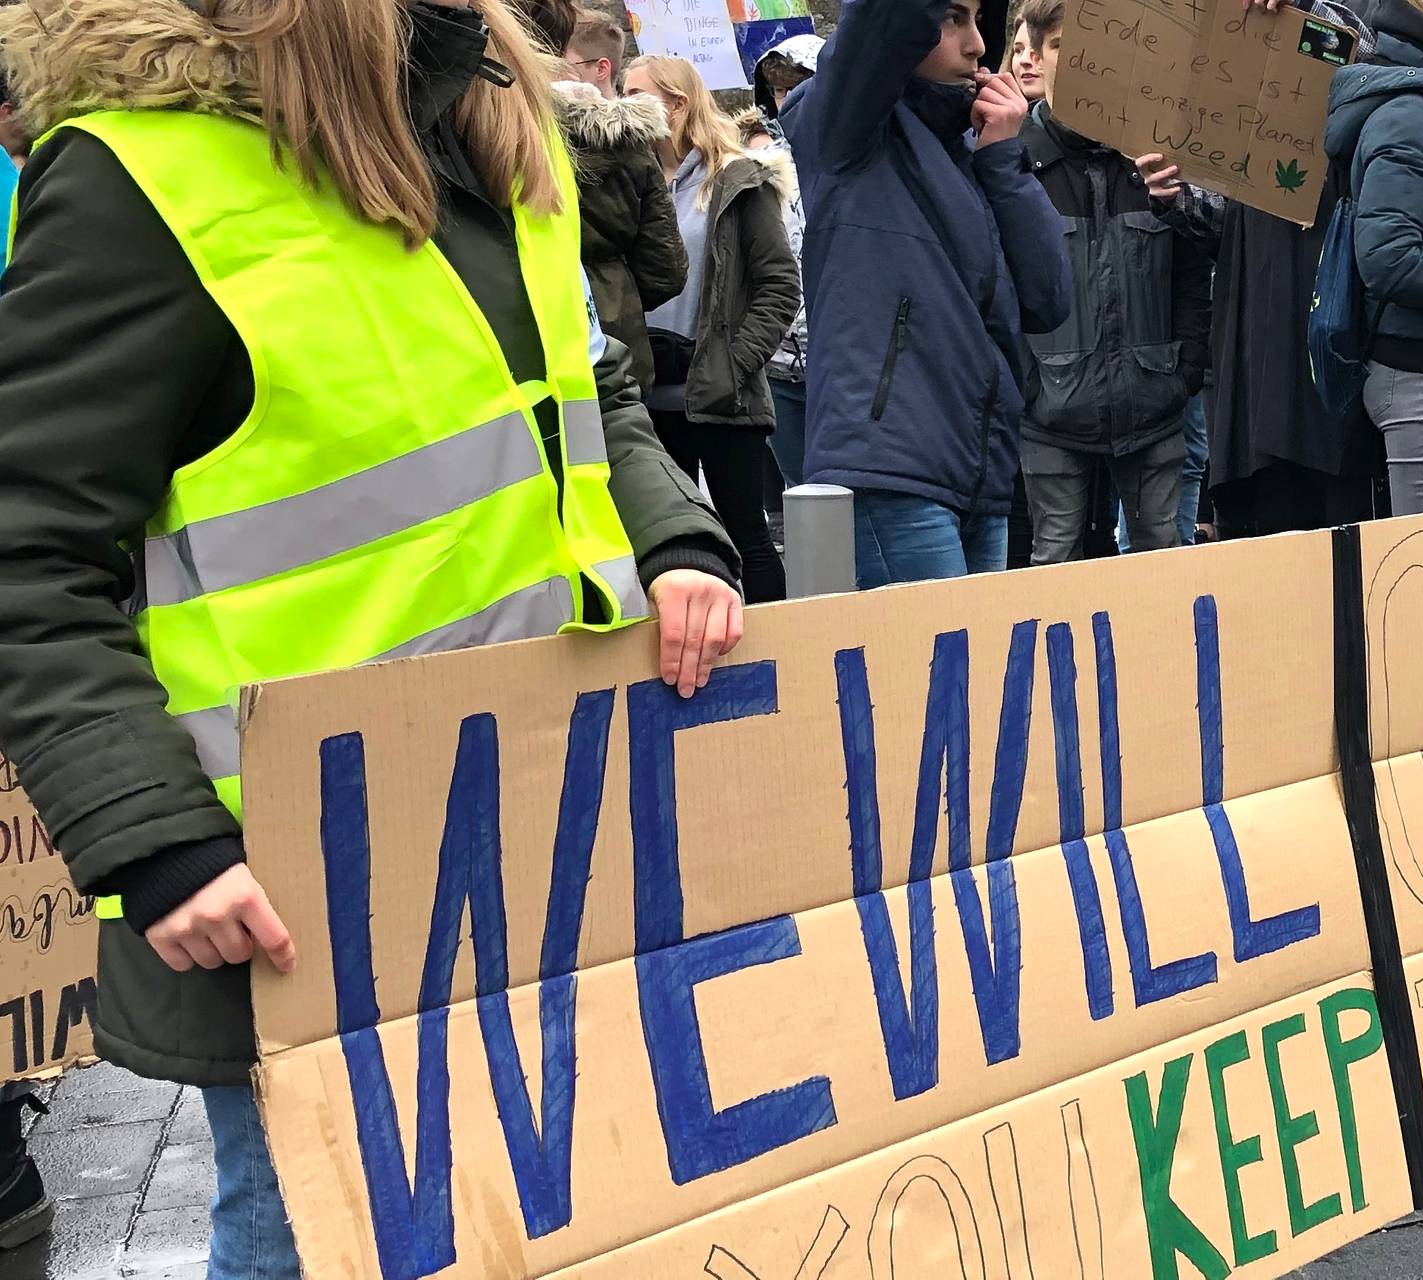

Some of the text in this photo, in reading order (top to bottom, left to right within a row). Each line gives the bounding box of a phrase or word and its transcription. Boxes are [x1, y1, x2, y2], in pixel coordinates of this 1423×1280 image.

[1069, 48, 1116, 78] der
[1238, 104, 1318, 155] Planet
[1075, 96, 1132, 127] mit
[1190, 53, 1233, 84] es
[1257, 76, 1306, 104] ist
[320, 659, 839, 1280] WE
[834, 593, 1321, 1101] WILL
[1124, 987, 1385, 1280] KEEP
